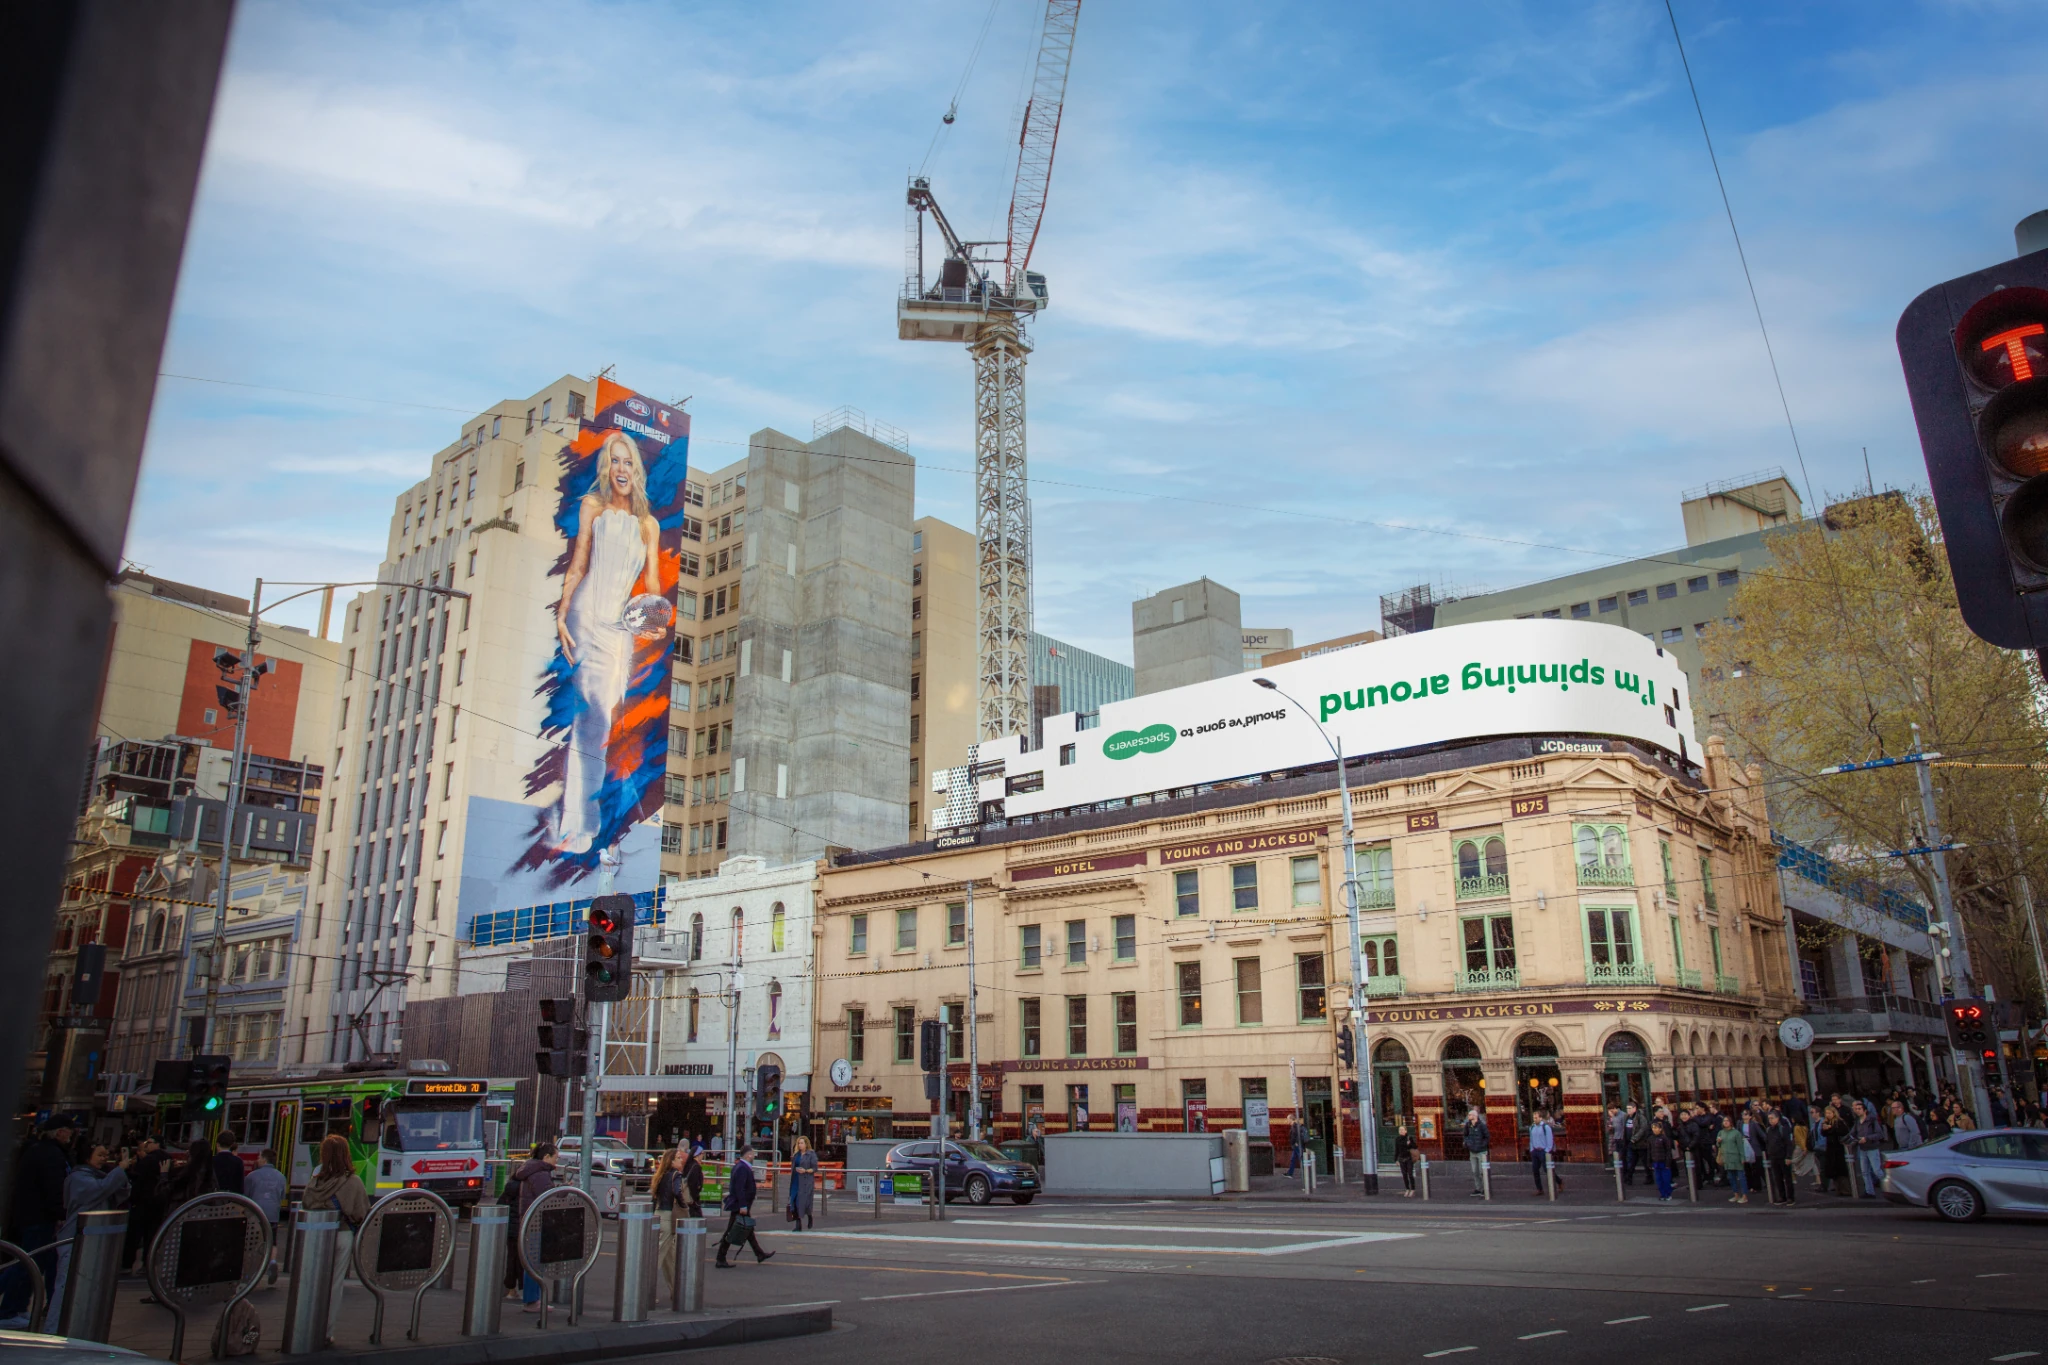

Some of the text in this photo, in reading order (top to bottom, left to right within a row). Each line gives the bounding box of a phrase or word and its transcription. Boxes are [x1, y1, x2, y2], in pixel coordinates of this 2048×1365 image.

[628, 401, 648, 414] AFL
[613, 413, 671, 445] ENTERTAINMENT
[1319, 658, 1656, 723] I'm spinning around
[1180, 708, 1286, 738] Should've gone to
[1109, 732, 1170, 752] Specsavers
[1540, 740, 1603, 753] JCDecaux
[1515, 800, 1544, 814] 1875
[936, 835, 975, 848] JCDecaux
[1165, 831, 1318, 860] YOUNG AND JACKSON
[1054, 862, 1095, 875] HOTEL
[1376, 1003, 1554, 1022] YOUNG & JACKSON
[664, 1064, 714, 1076] DANGERFIELD
[1016, 1060, 1059, 1070] YOUNG
[1073, 1059, 1137, 1069] JACKSON
